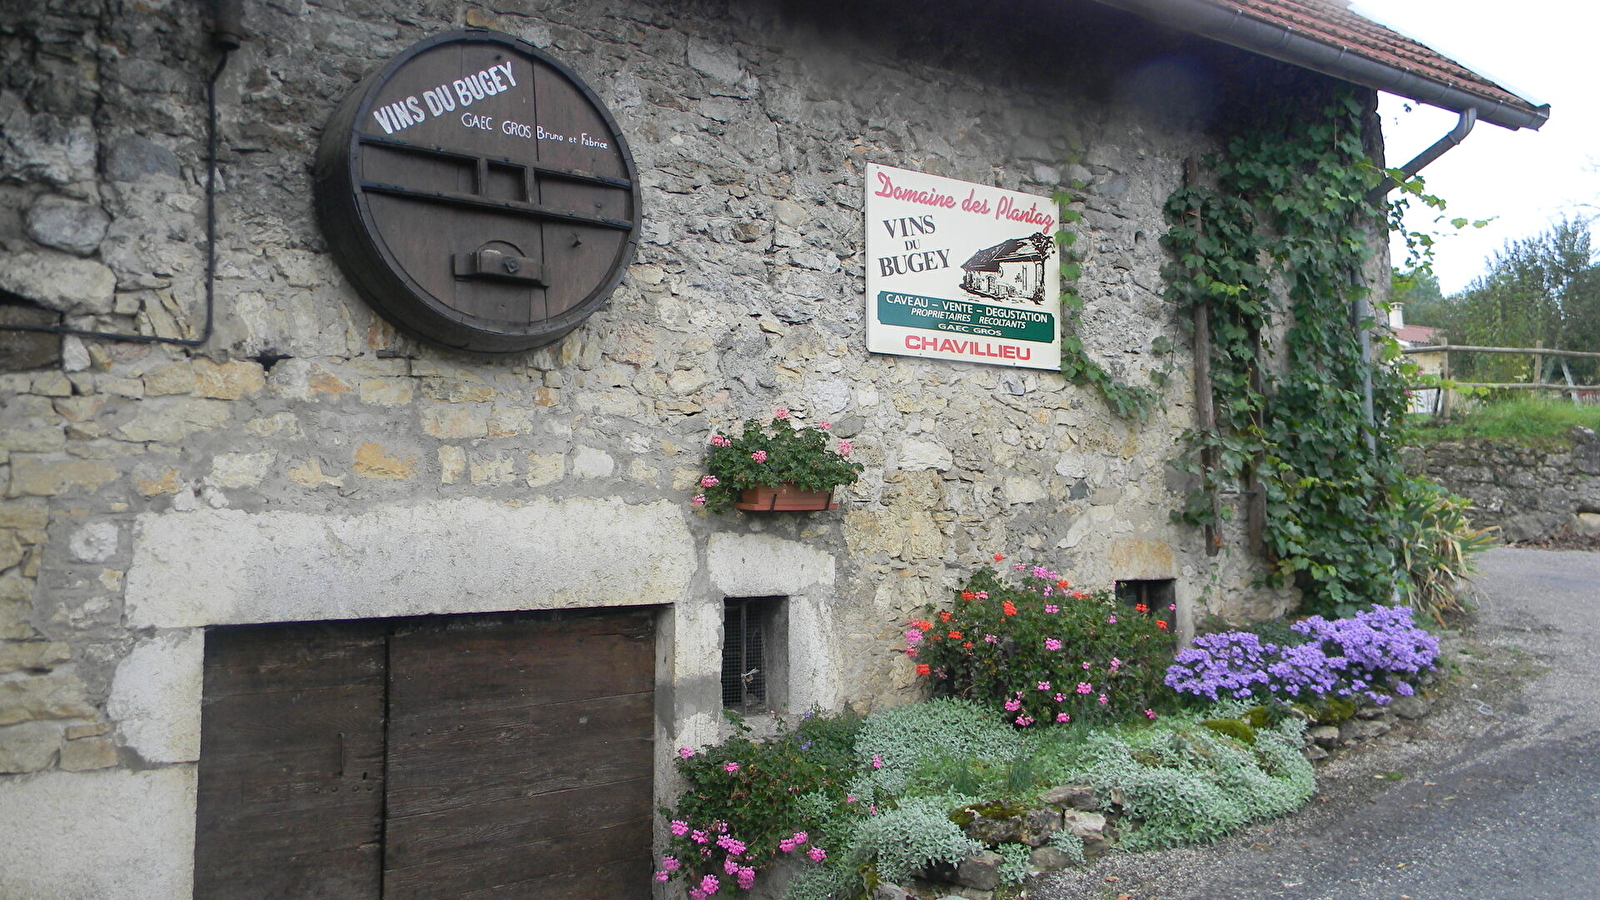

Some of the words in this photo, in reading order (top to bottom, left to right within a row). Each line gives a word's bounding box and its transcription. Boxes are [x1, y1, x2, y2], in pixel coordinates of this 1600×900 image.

[374, 96, 425, 134] VINS
[423, 84, 456, 117] DU
[453, 61, 517, 106] BUGEY
[461, 112, 493, 131] GAEC
[502, 121, 532, 138] GROS
[536, 125, 564, 142] Bruno
[581, 132, 608, 150] Fabrice
[875, 171, 956, 209] Domaine
[961, 188, 991, 215] des
[995, 196, 1056, 235] Plantaz
[882, 214, 936, 239] VINS
[904, 238, 921, 251] DU
[877, 249, 950, 278] BUGEY
[885, 293, 929, 308] CAVEAU
[942, 300, 974, 314] VENTE
[985, 306, 1048, 323] DEGUSTATION
[911, 307, 971, 322] PROPRIETAIRES
[978, 315, 1027, 329] RECOLTANTS
[937, 323, 970, 333] GAEC
[973, 327, 1002, 337] GROS
[904, 335, 1031, 361] CHAVILLIEU
